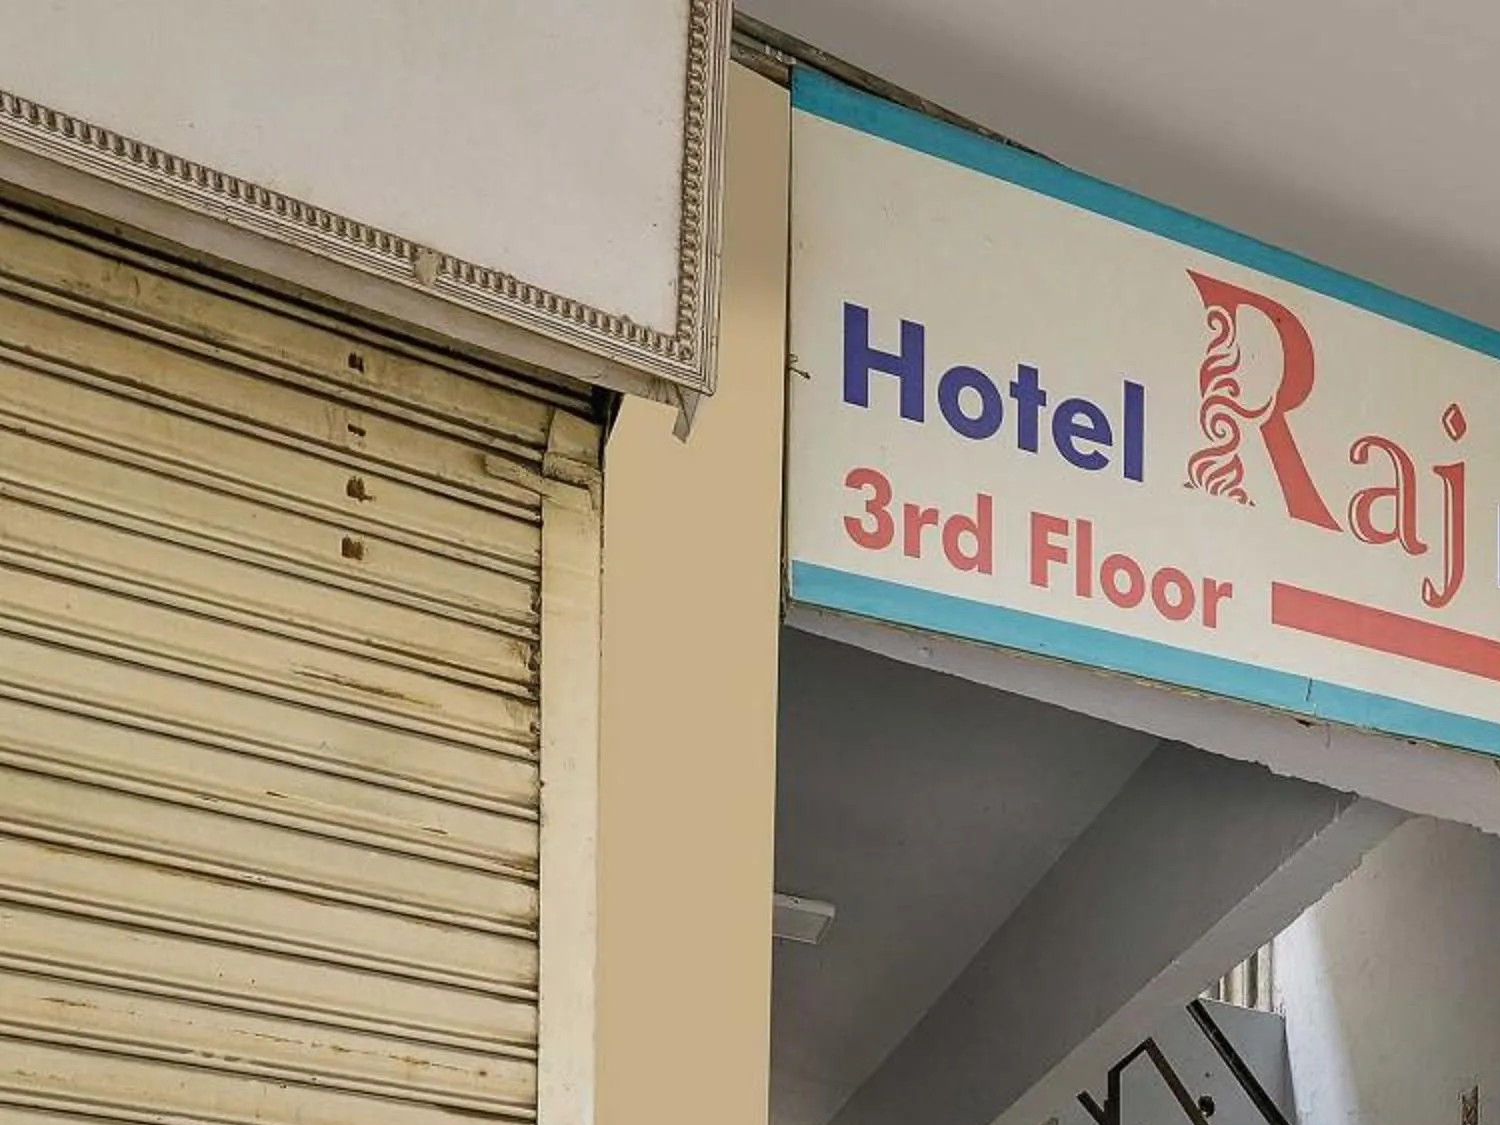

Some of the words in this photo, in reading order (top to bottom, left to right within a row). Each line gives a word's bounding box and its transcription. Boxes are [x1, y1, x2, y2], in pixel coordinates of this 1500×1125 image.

[843, 302, 1145, 482] Hotel
[1184, 269, 1467, 608] Raj
[843, 468, 993, 574] 3rd
[1030, 511, 1232, 628] Floor
